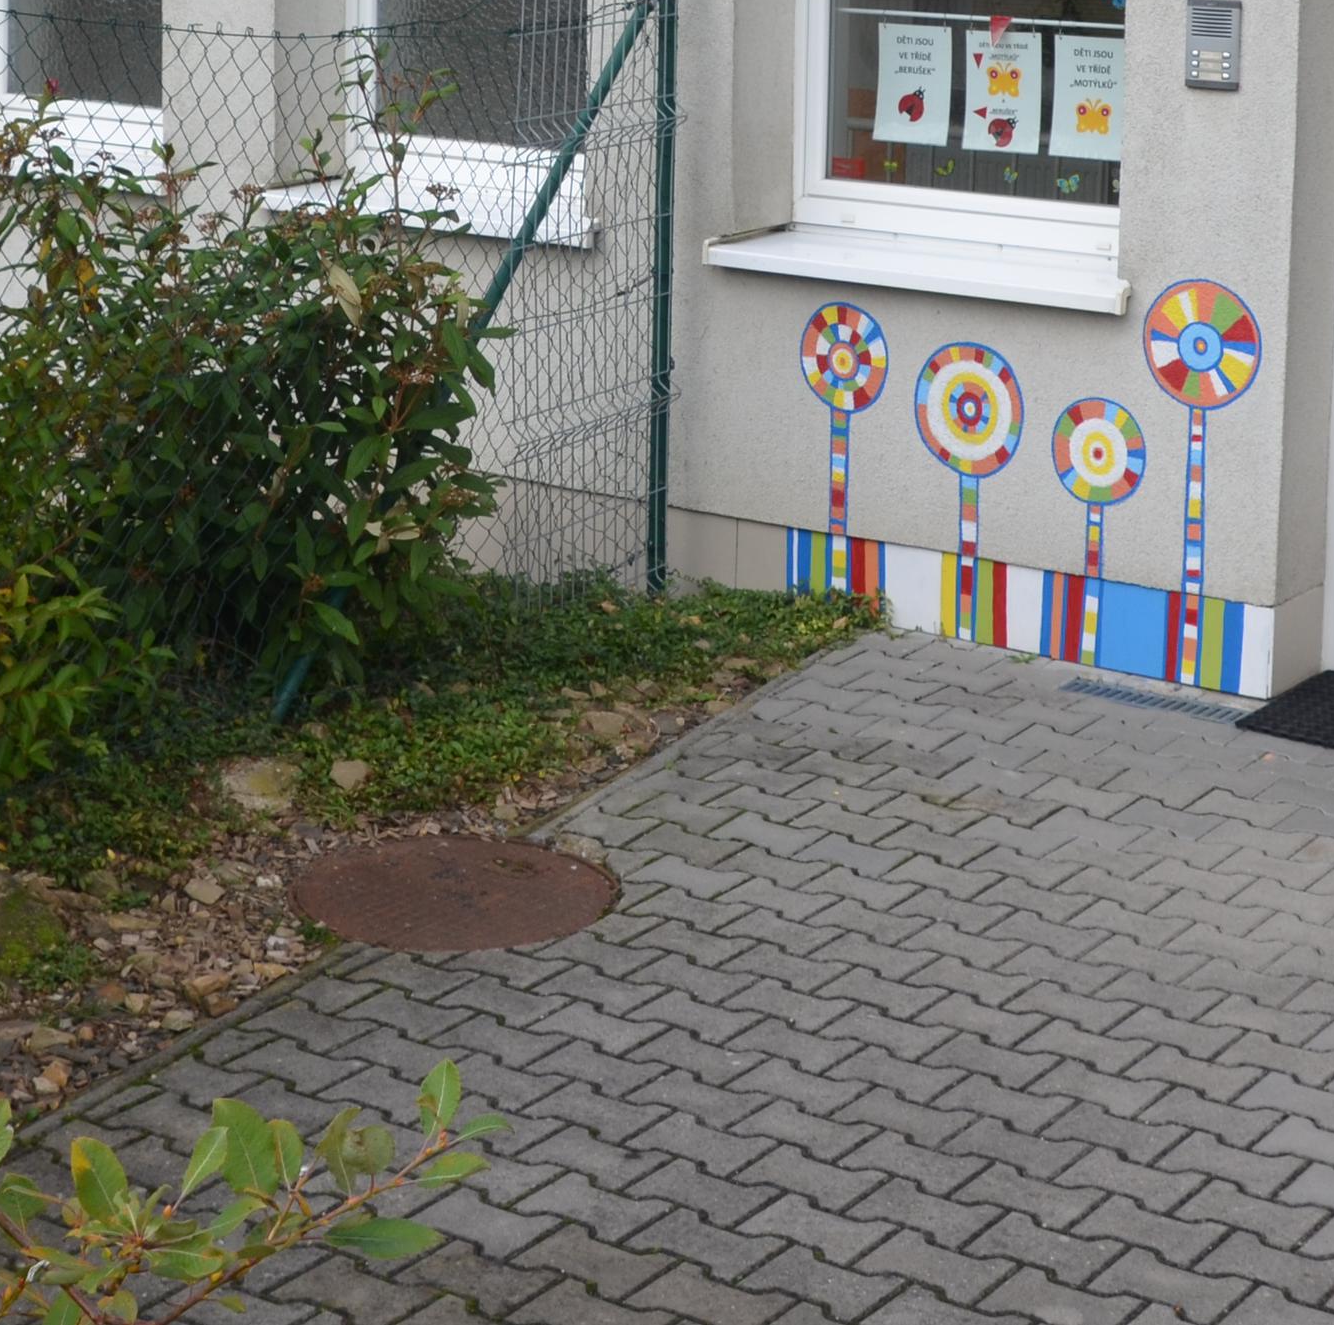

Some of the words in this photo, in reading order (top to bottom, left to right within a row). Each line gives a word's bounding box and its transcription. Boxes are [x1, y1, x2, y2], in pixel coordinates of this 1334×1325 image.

[896, 35, 913, 45] DĚTI
[914, 37, 935, 47] JSOU
[898, 51, 908, 60] VE
[910, 51, 932, 62] TŘÍDĚ
[1073, 47, 1092, 57] DĚTI
[1093, 49, 1114, 59] JSOU
[1076, 64, 1087, 74] VE
[1088, 64, 1111, 75] TŘÍDĚ
